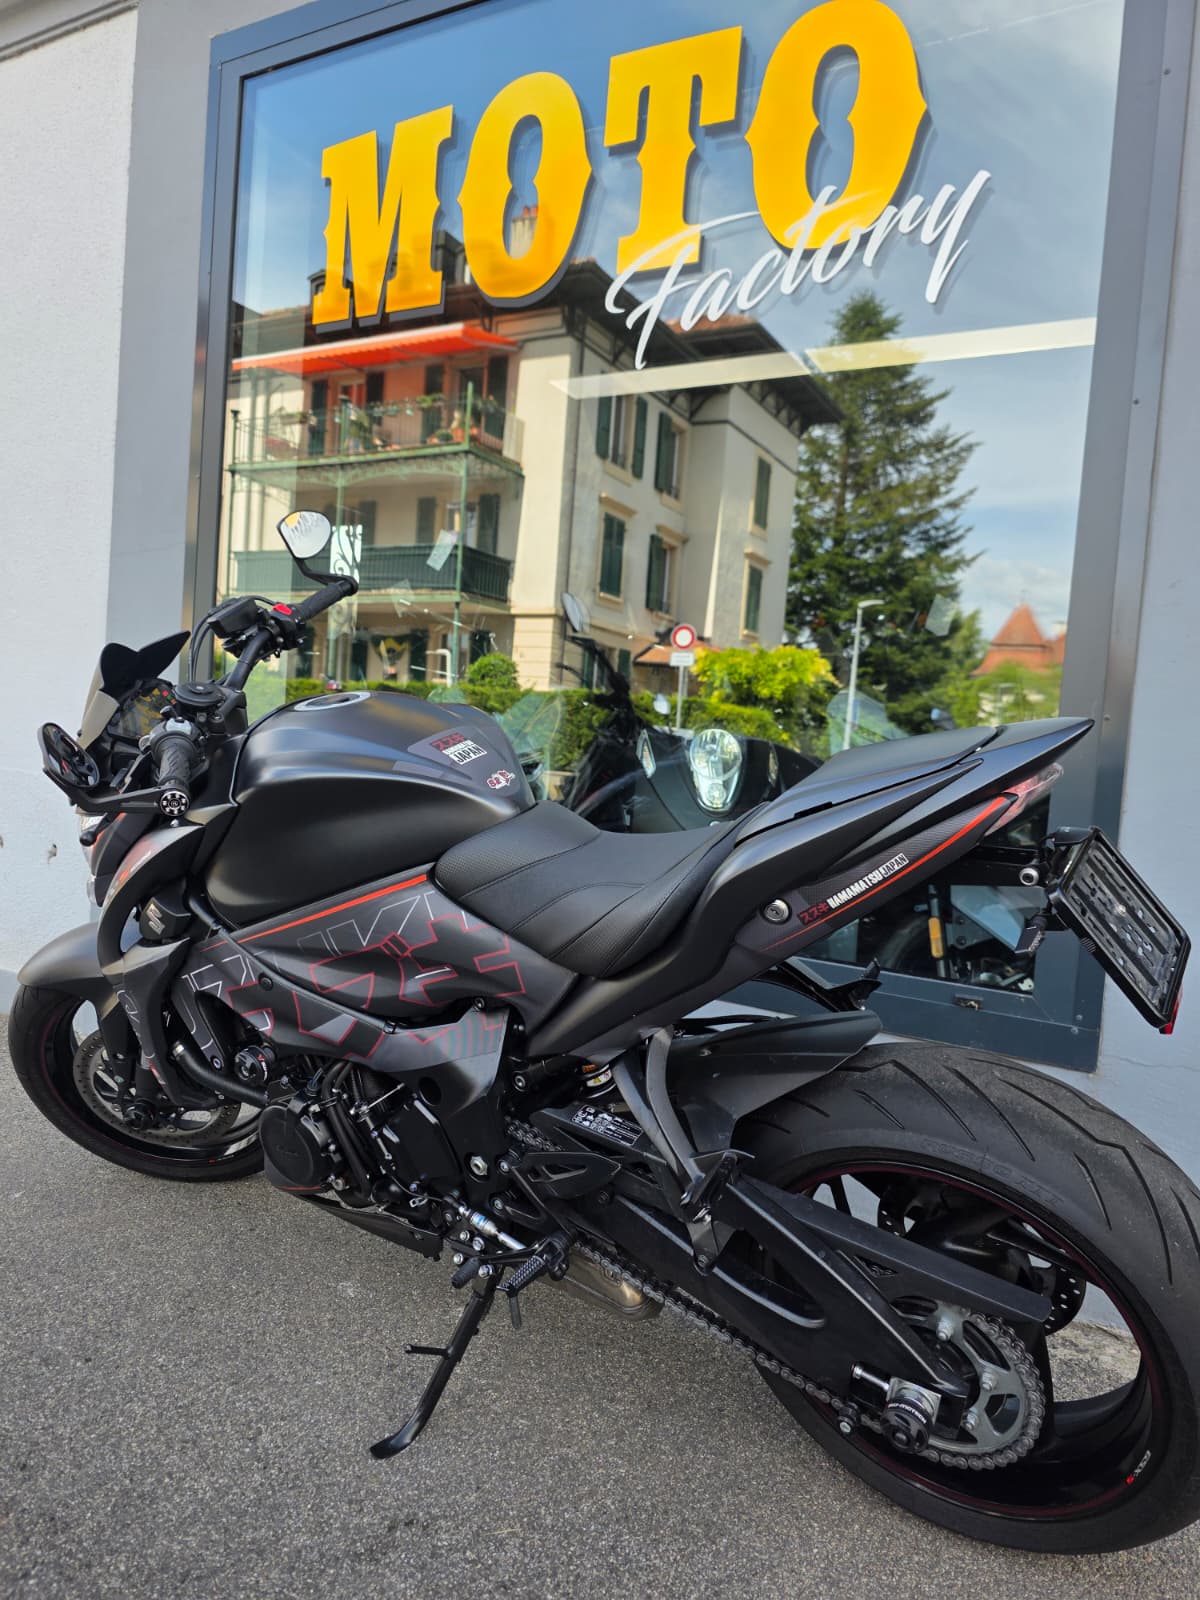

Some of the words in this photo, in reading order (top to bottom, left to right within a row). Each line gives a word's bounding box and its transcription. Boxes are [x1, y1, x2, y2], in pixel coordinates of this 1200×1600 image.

[312, 0, 929, 328] MOTO
[604, 169, 992, 371] Factory
[451, 746, 486, 765] JAPAN
[827, 869, 884, 909] HAMAMATSU
[880, 853, 909, 878] JAPAN
